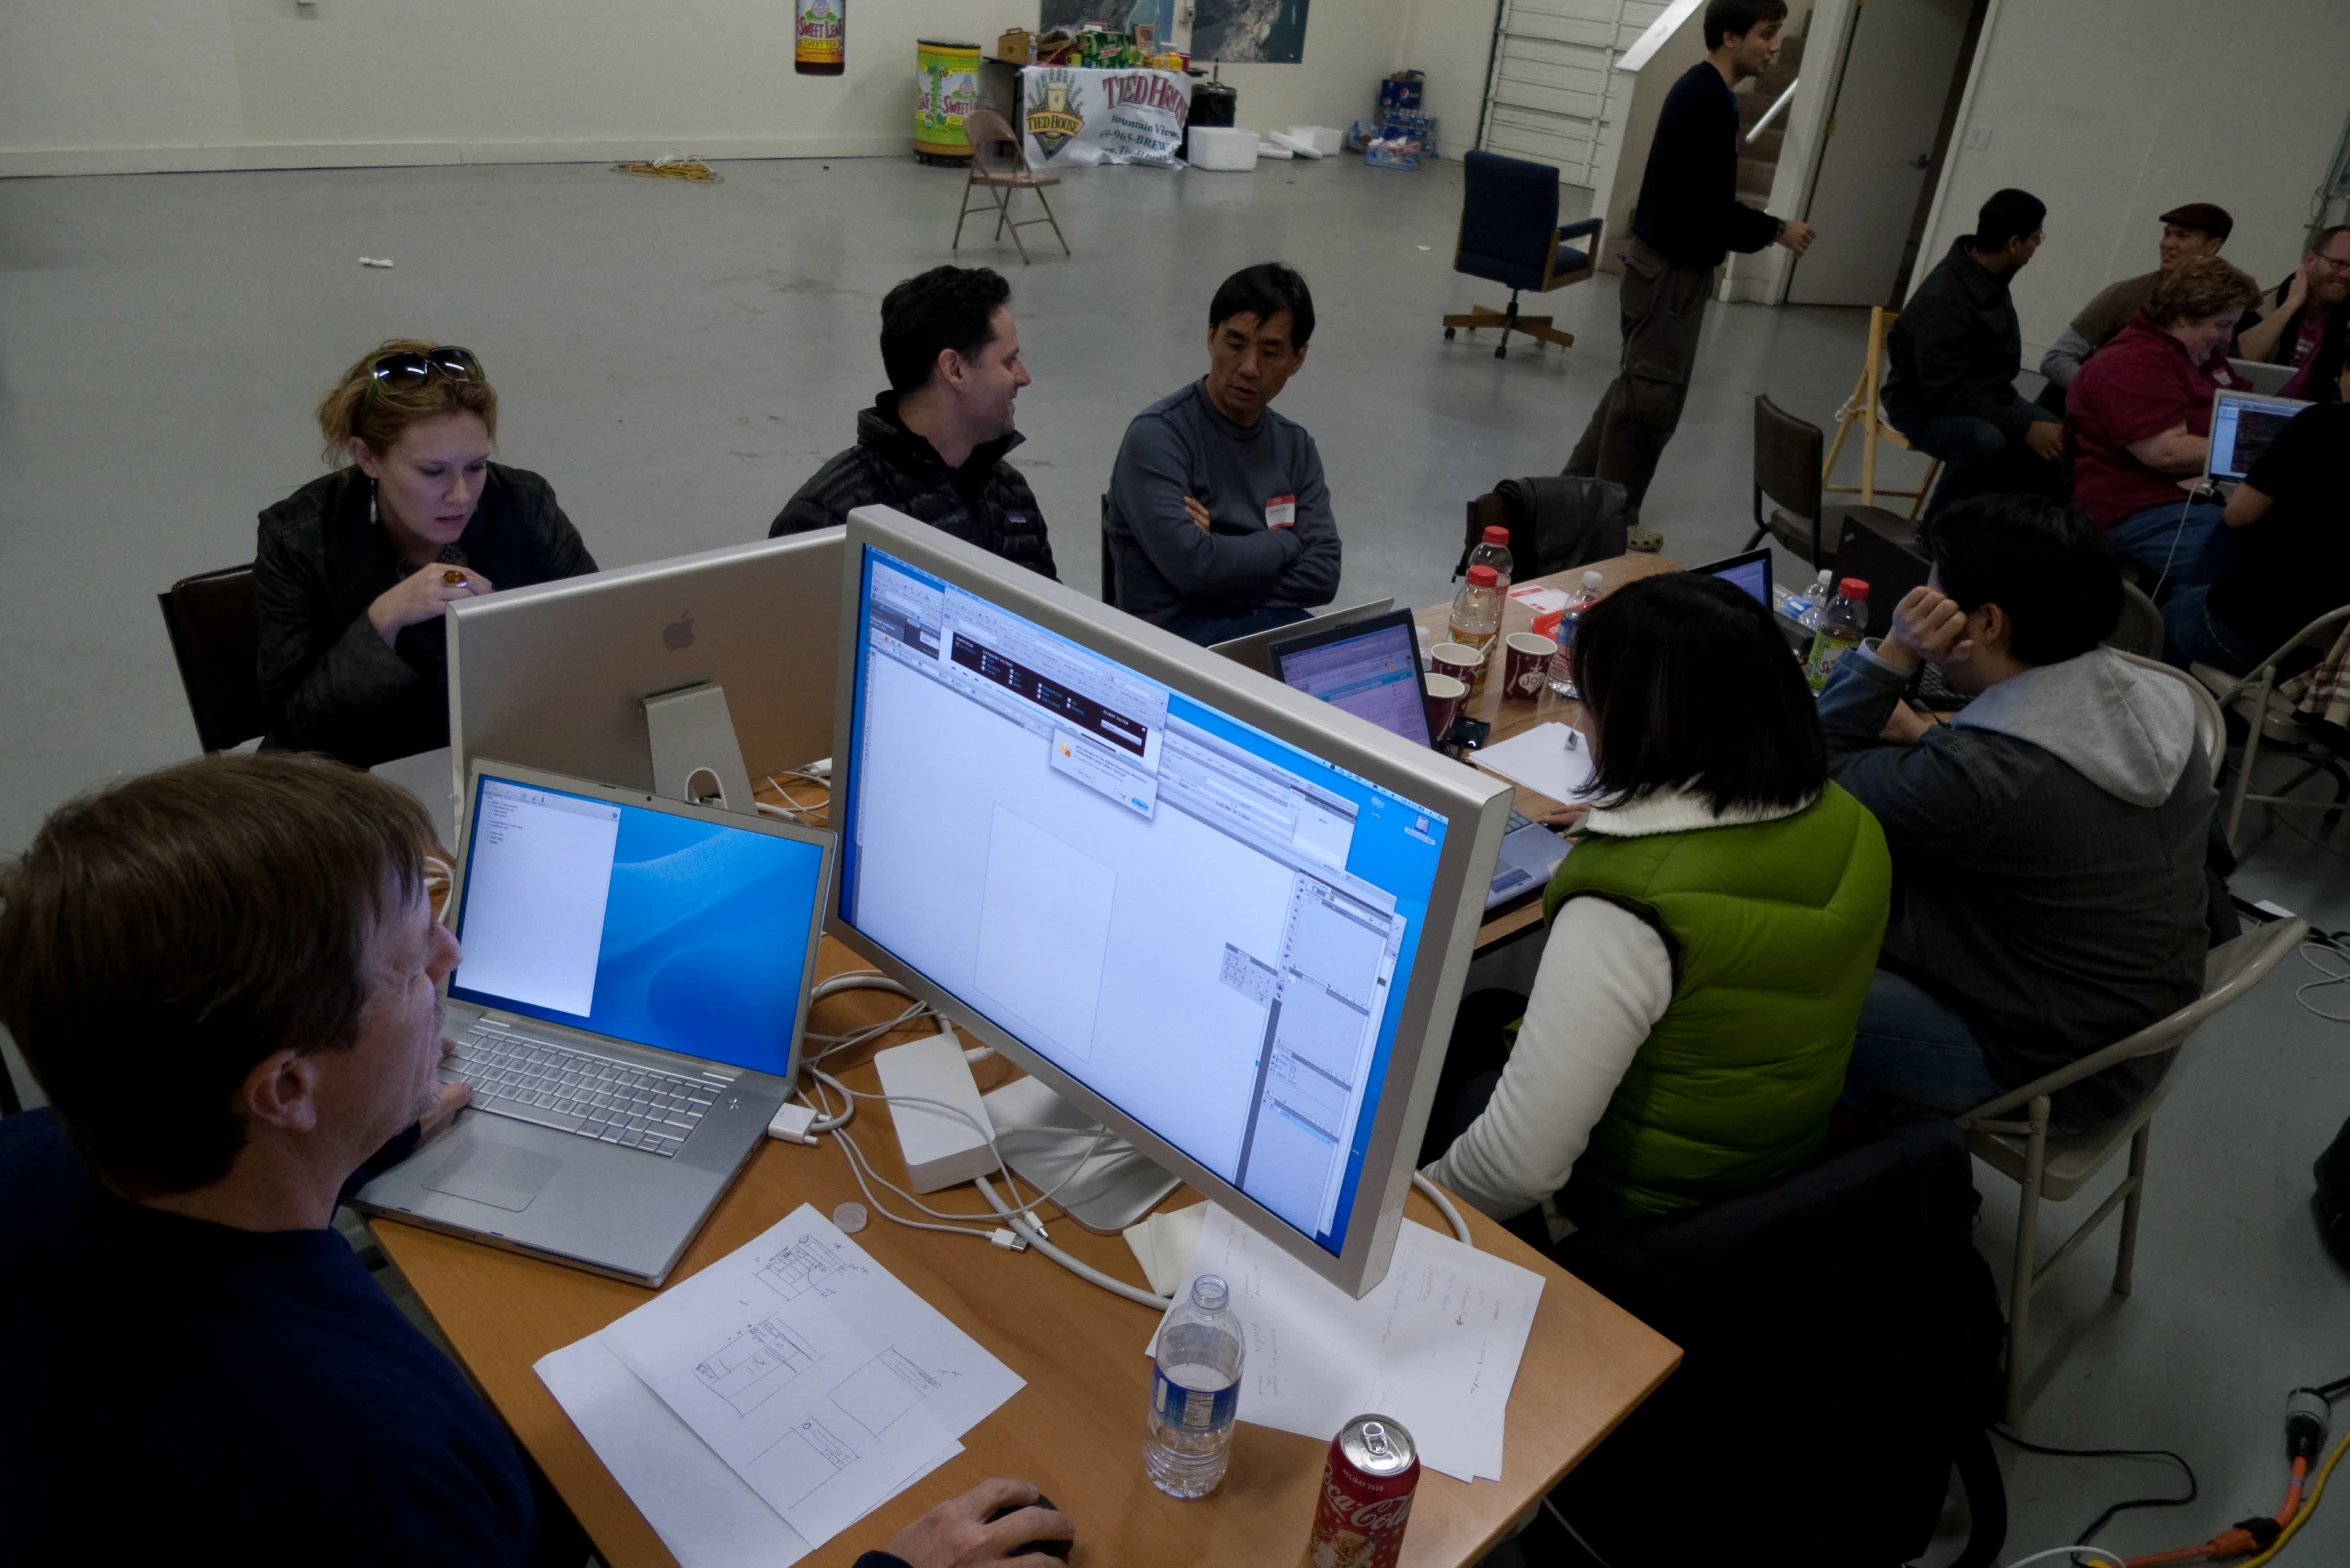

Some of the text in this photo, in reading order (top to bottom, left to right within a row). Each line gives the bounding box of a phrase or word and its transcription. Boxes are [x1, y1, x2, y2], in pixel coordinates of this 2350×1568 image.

[1102, 75, 1148, 110] TIED
[1026, 115, 1080, 133] TIED HOUSE
[1342, 1468, 1385, 1492] HOLIDAY 2009
